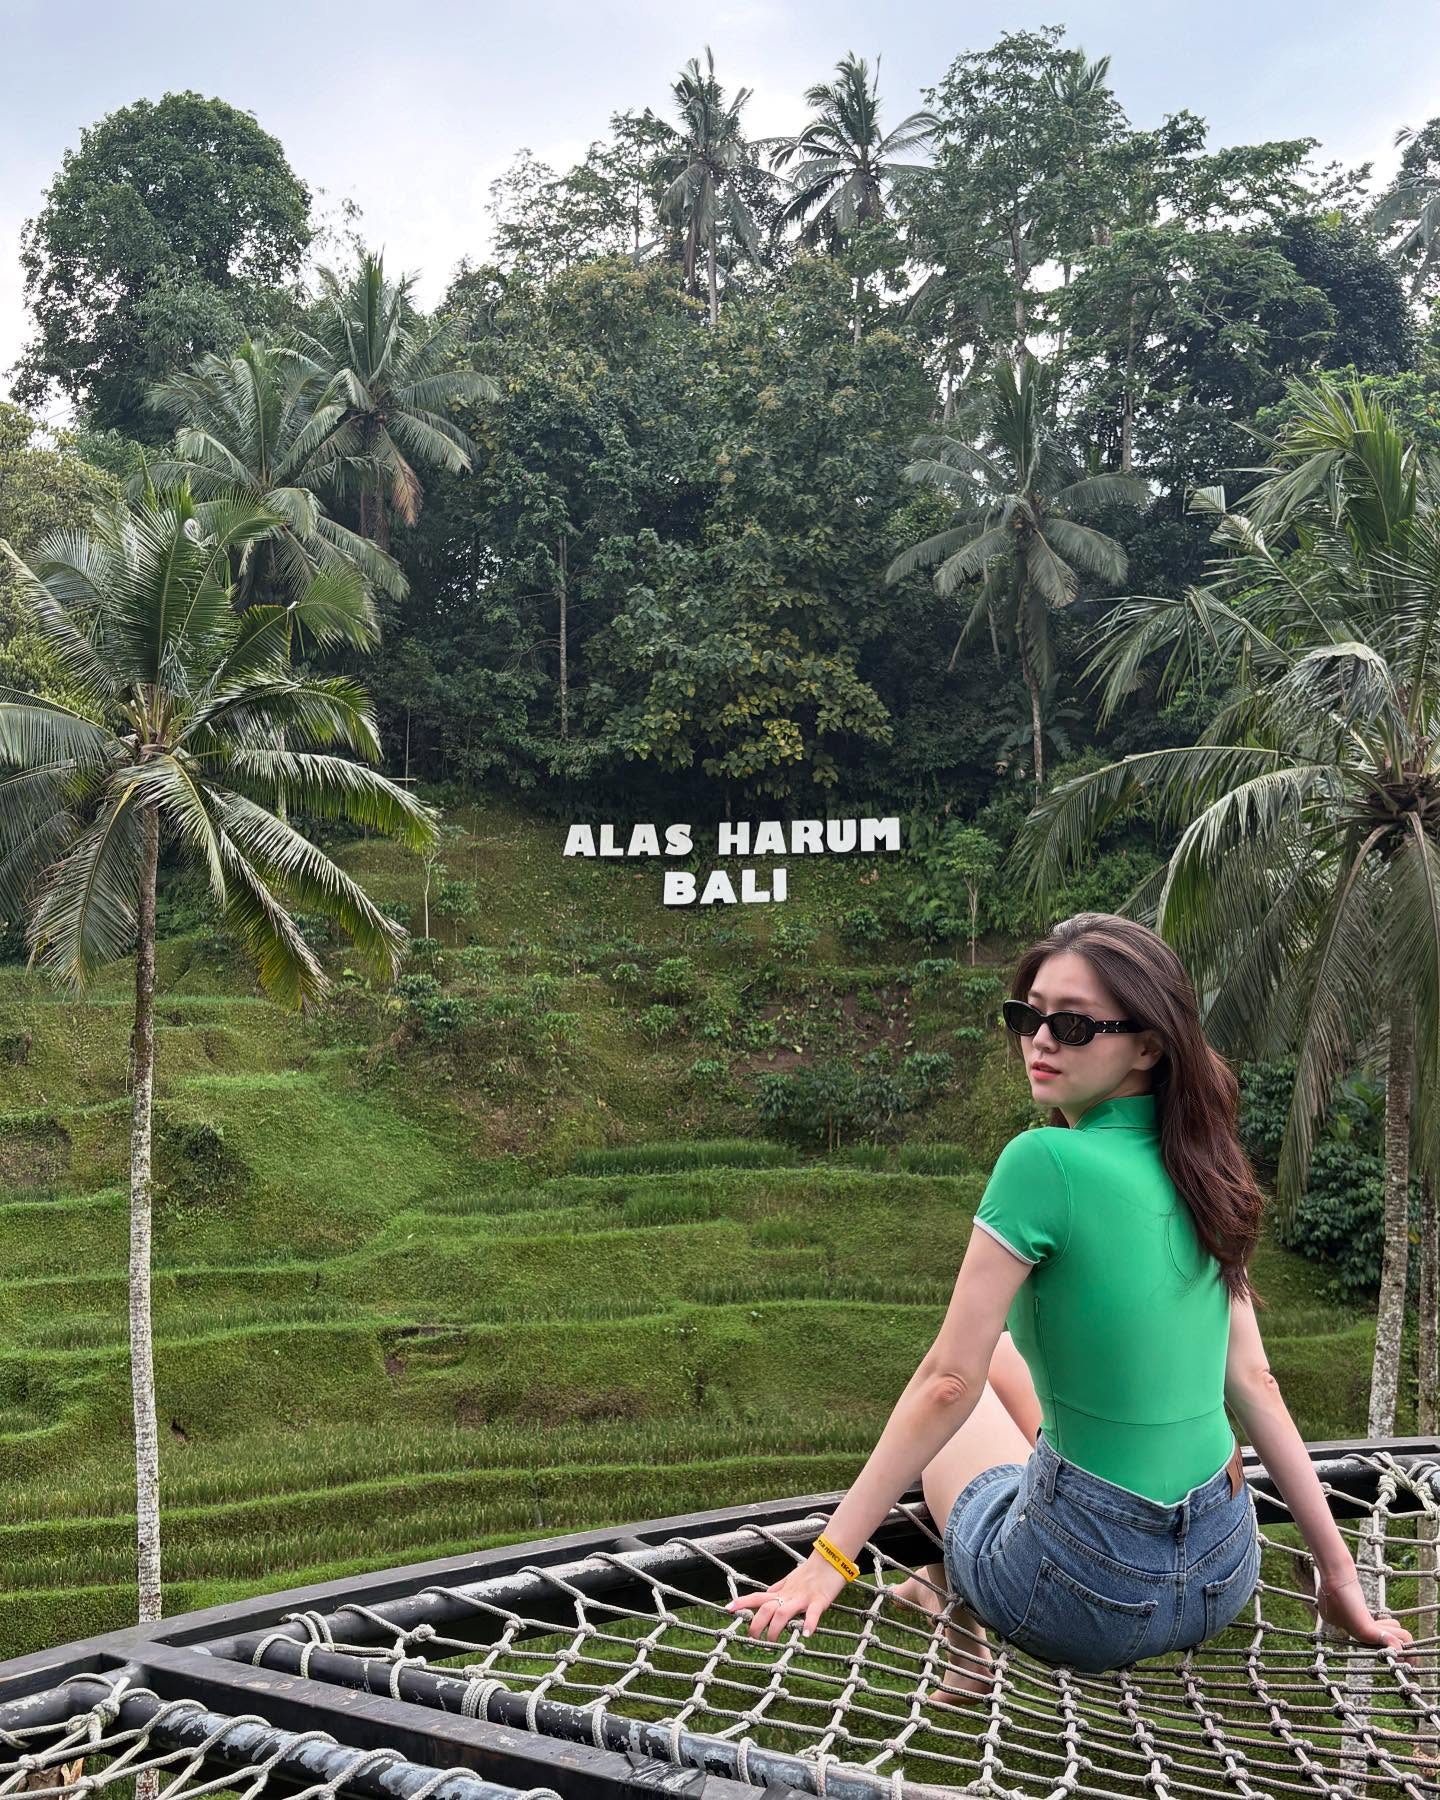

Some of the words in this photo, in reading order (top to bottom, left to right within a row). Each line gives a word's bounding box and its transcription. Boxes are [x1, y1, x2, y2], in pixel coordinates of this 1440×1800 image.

[563, 824, 694, 857] ALAS
[718, 817, 900, 855] HARUM
[663, 868, 787, 905] BALI
